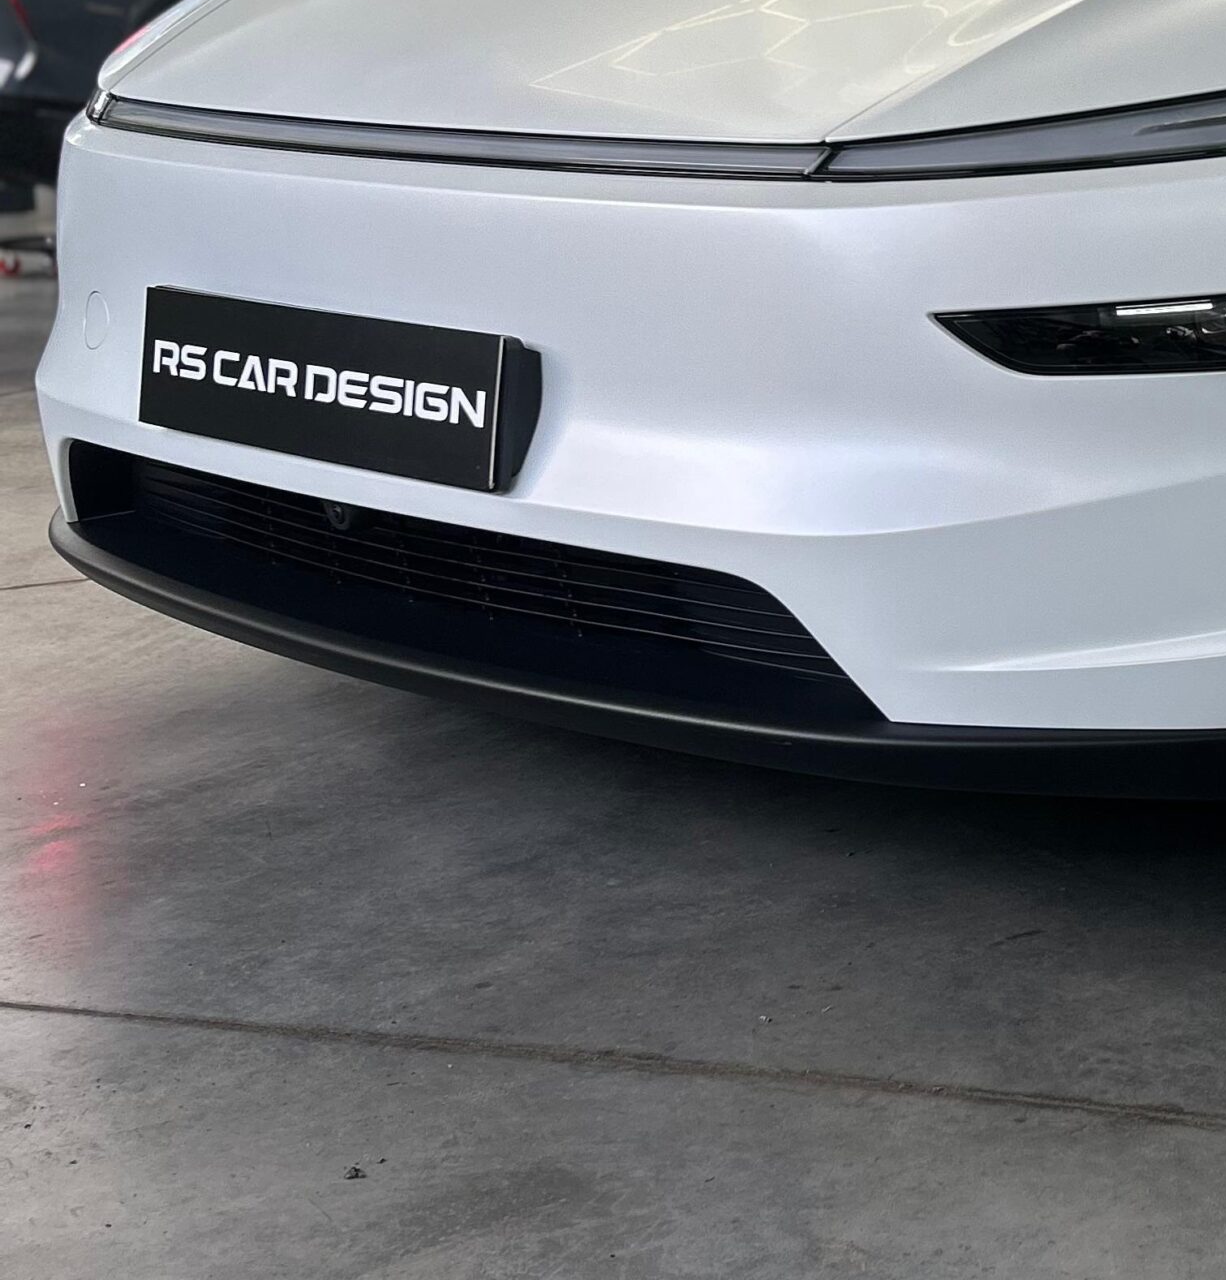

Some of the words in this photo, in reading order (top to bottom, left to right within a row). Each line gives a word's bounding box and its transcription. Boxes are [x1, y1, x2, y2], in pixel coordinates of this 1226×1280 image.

[152, 339, 208, 381] RS
[212, 349, 299, 398] CAR
[304, 364, 487, 429] DESIGN
